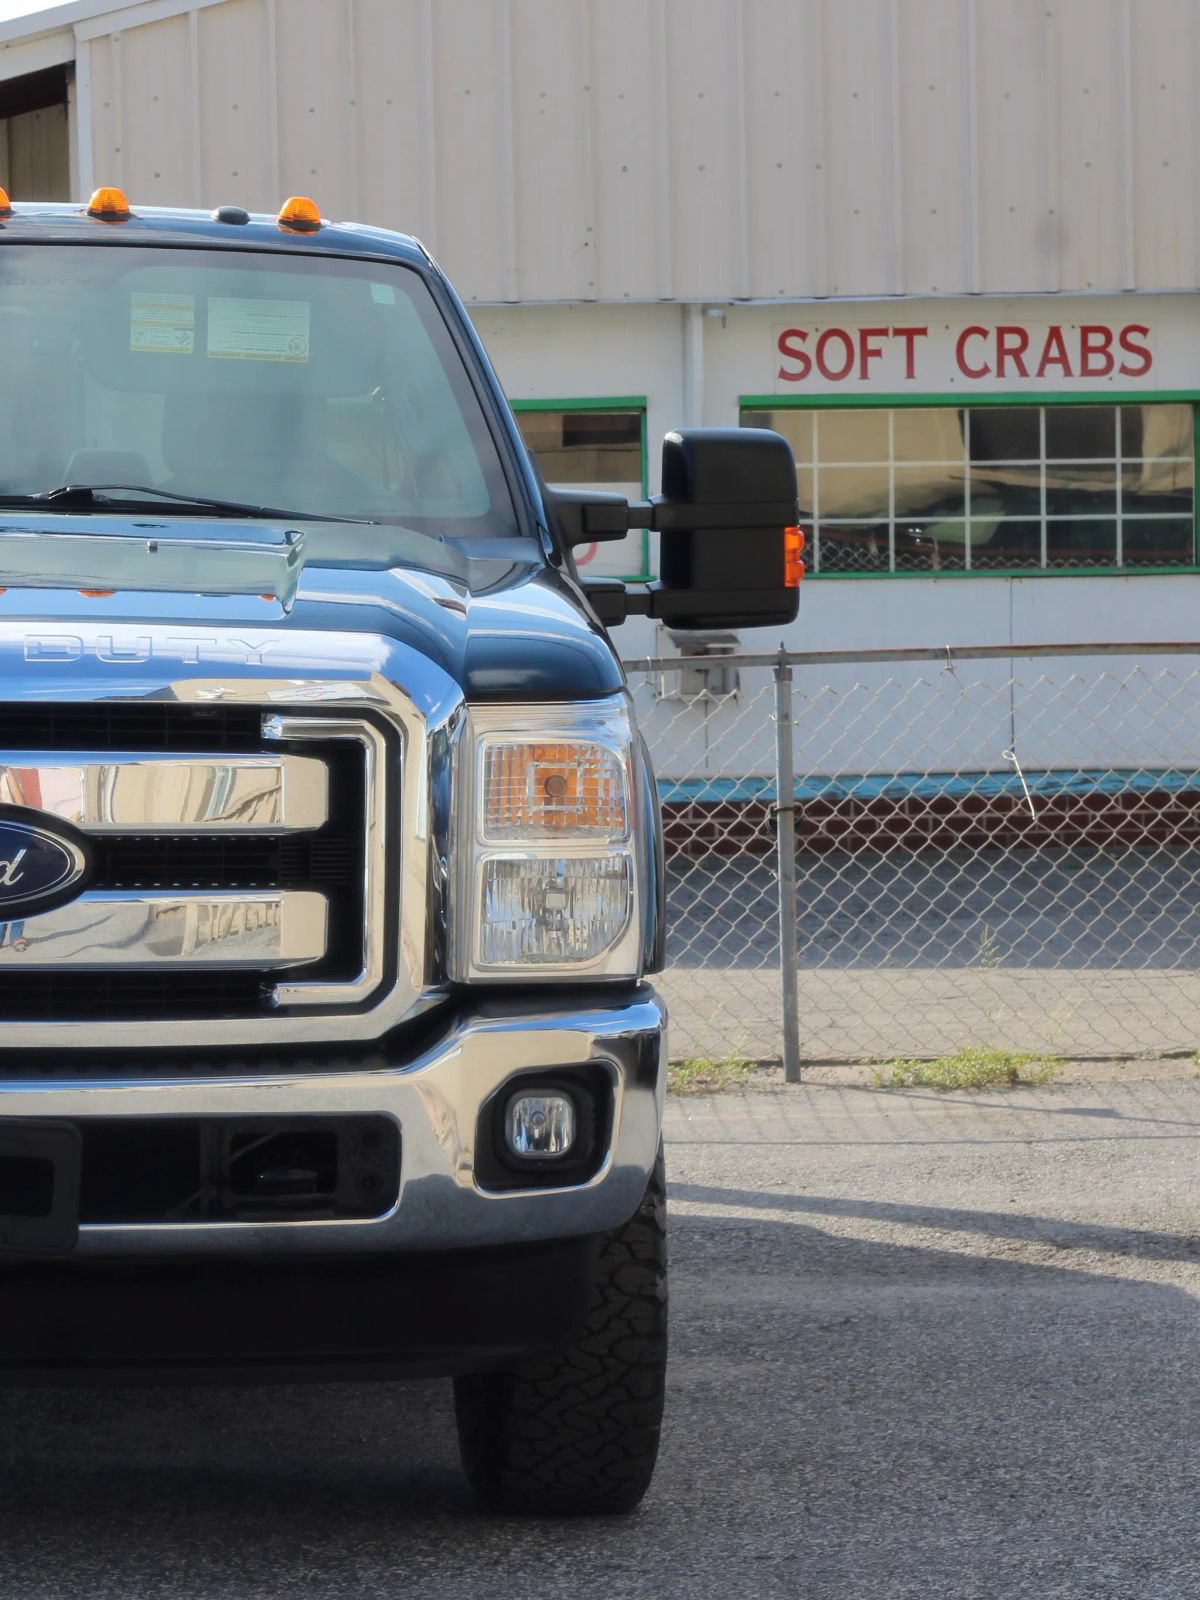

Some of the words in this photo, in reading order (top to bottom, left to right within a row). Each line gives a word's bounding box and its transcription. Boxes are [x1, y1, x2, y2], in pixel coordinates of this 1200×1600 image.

[777, 325, 929, 382] SOFT
[956, 323, 1154, 379] CRABS
[23, 633, 281, 666] DUTY
